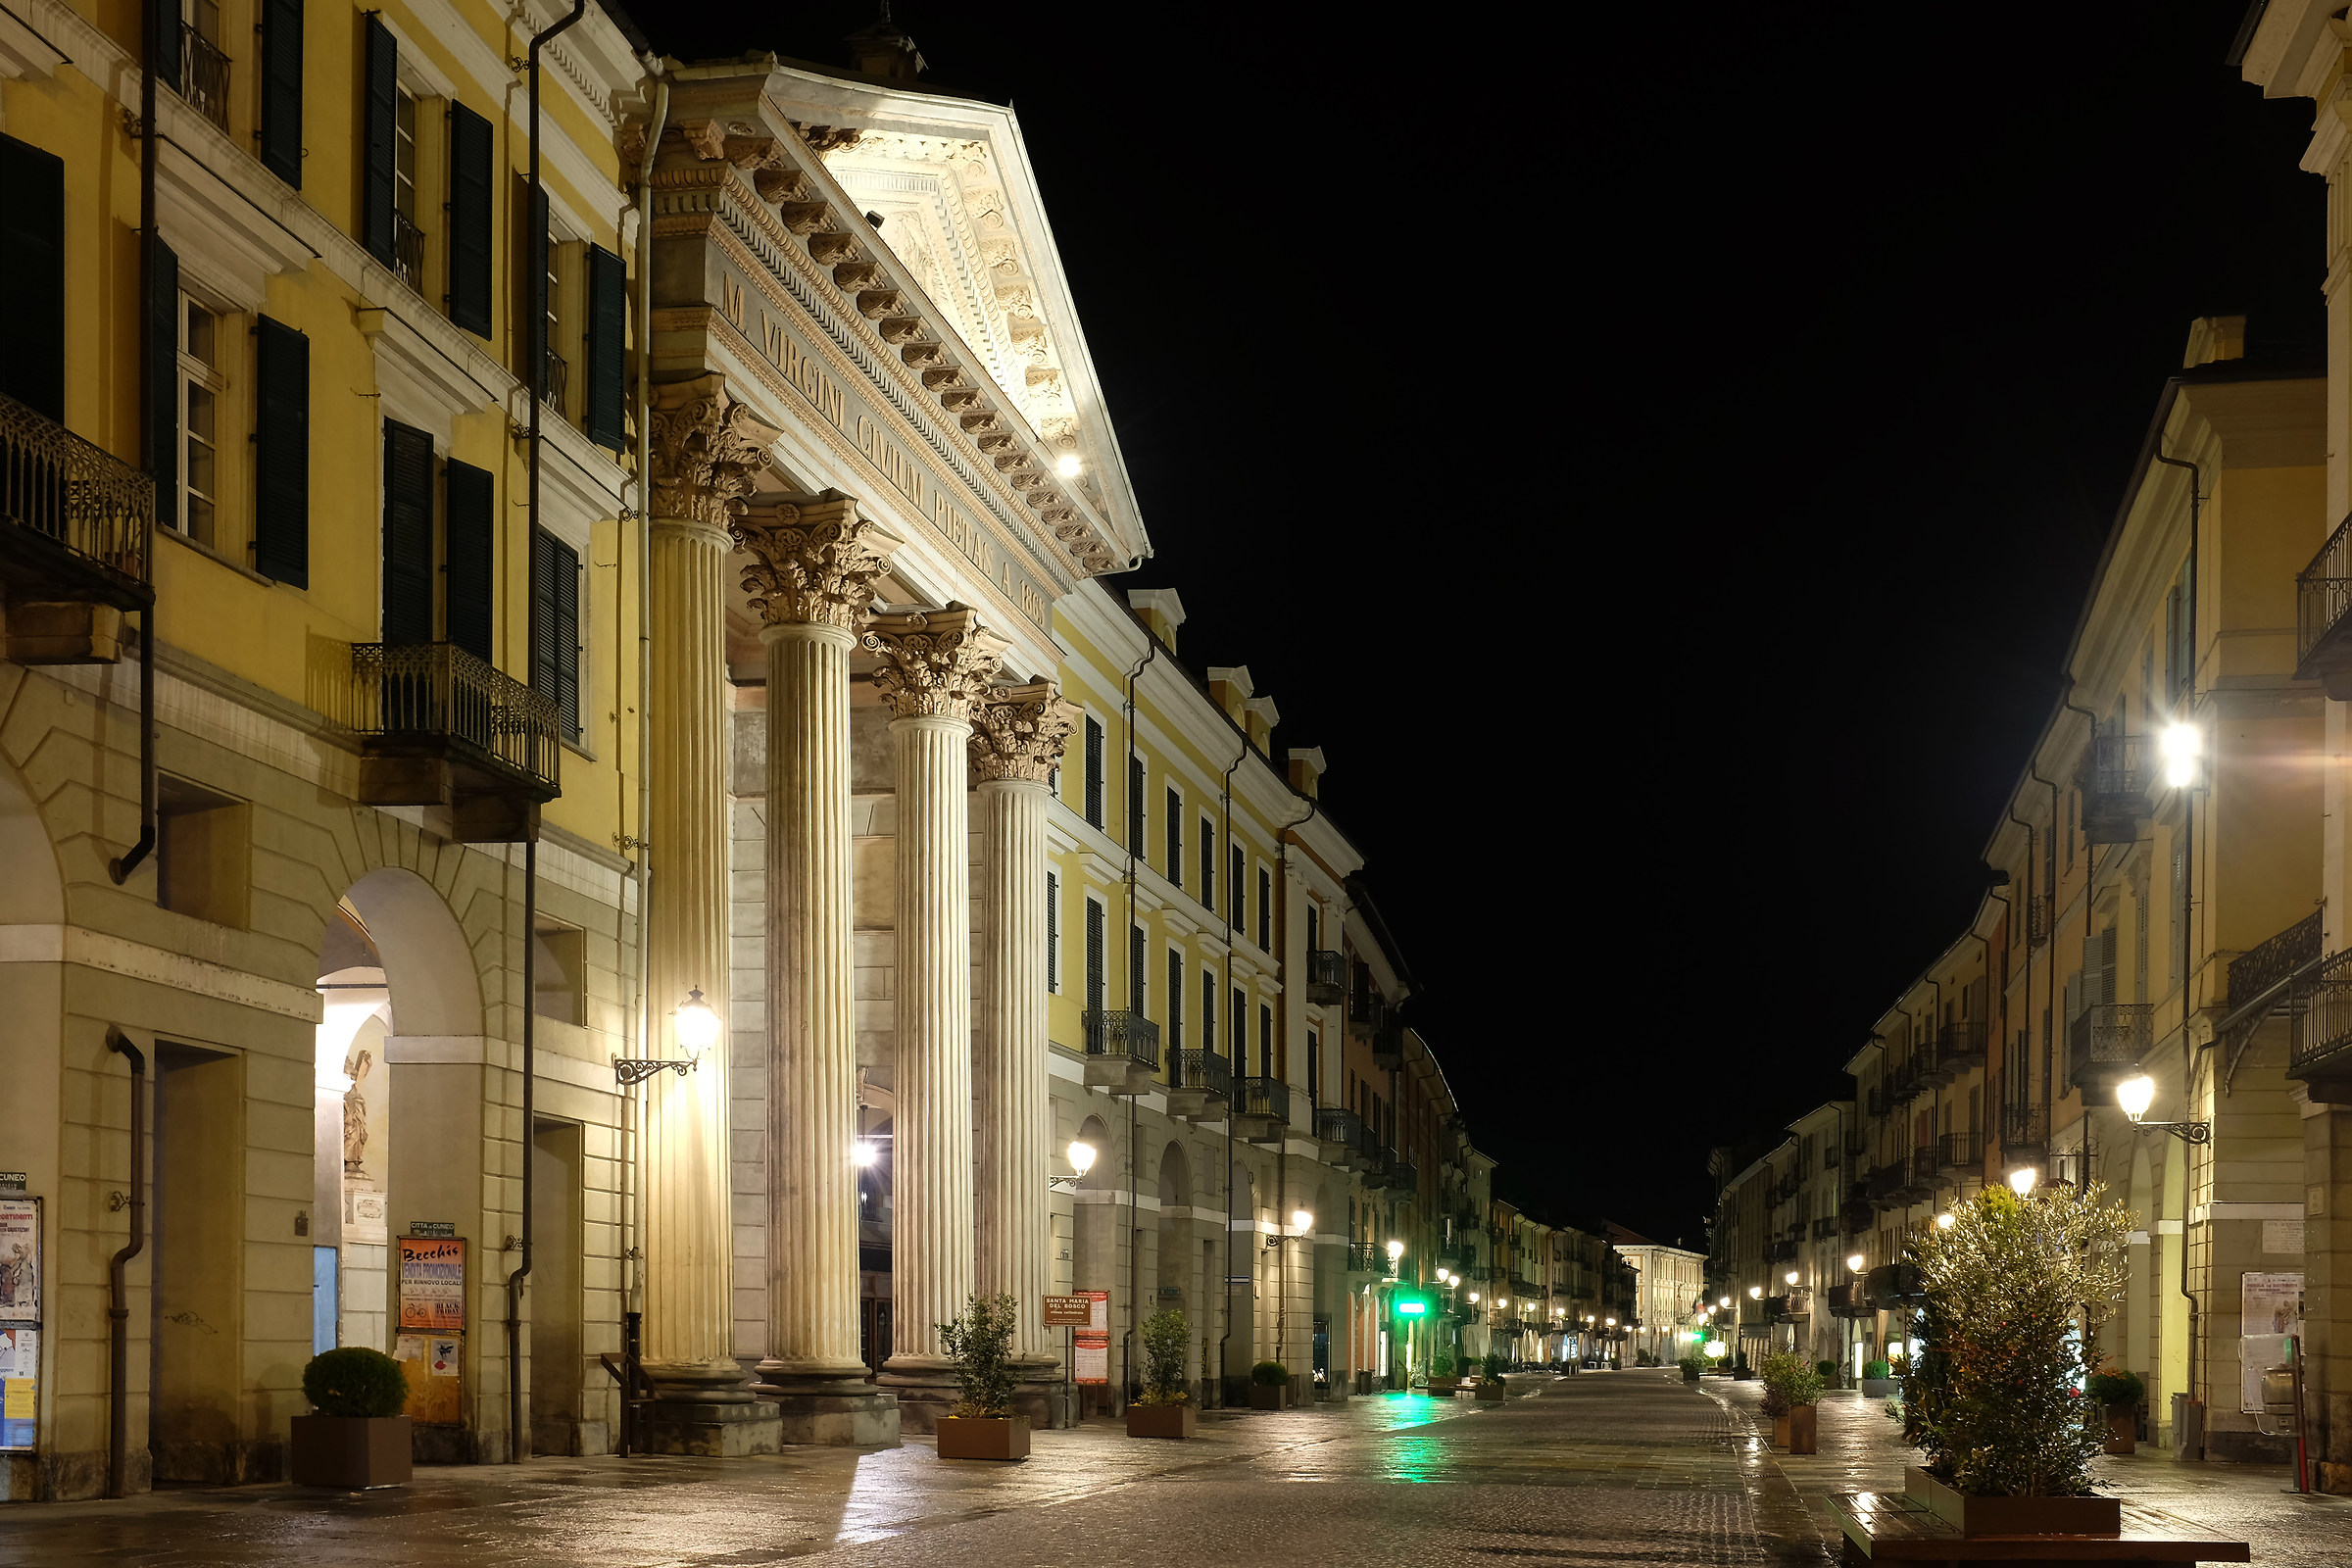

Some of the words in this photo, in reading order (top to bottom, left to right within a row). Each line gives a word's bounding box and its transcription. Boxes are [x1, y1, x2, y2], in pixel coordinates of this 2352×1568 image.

[760, 310, 845, 430] VIRGINI
[857, 415, 924, 509] CIVIUM
[933, 490, 993, 574] PIETAS
[1019, 579, 1046, 625] 1865
[403, 1245, 459, 1261] Becchis
